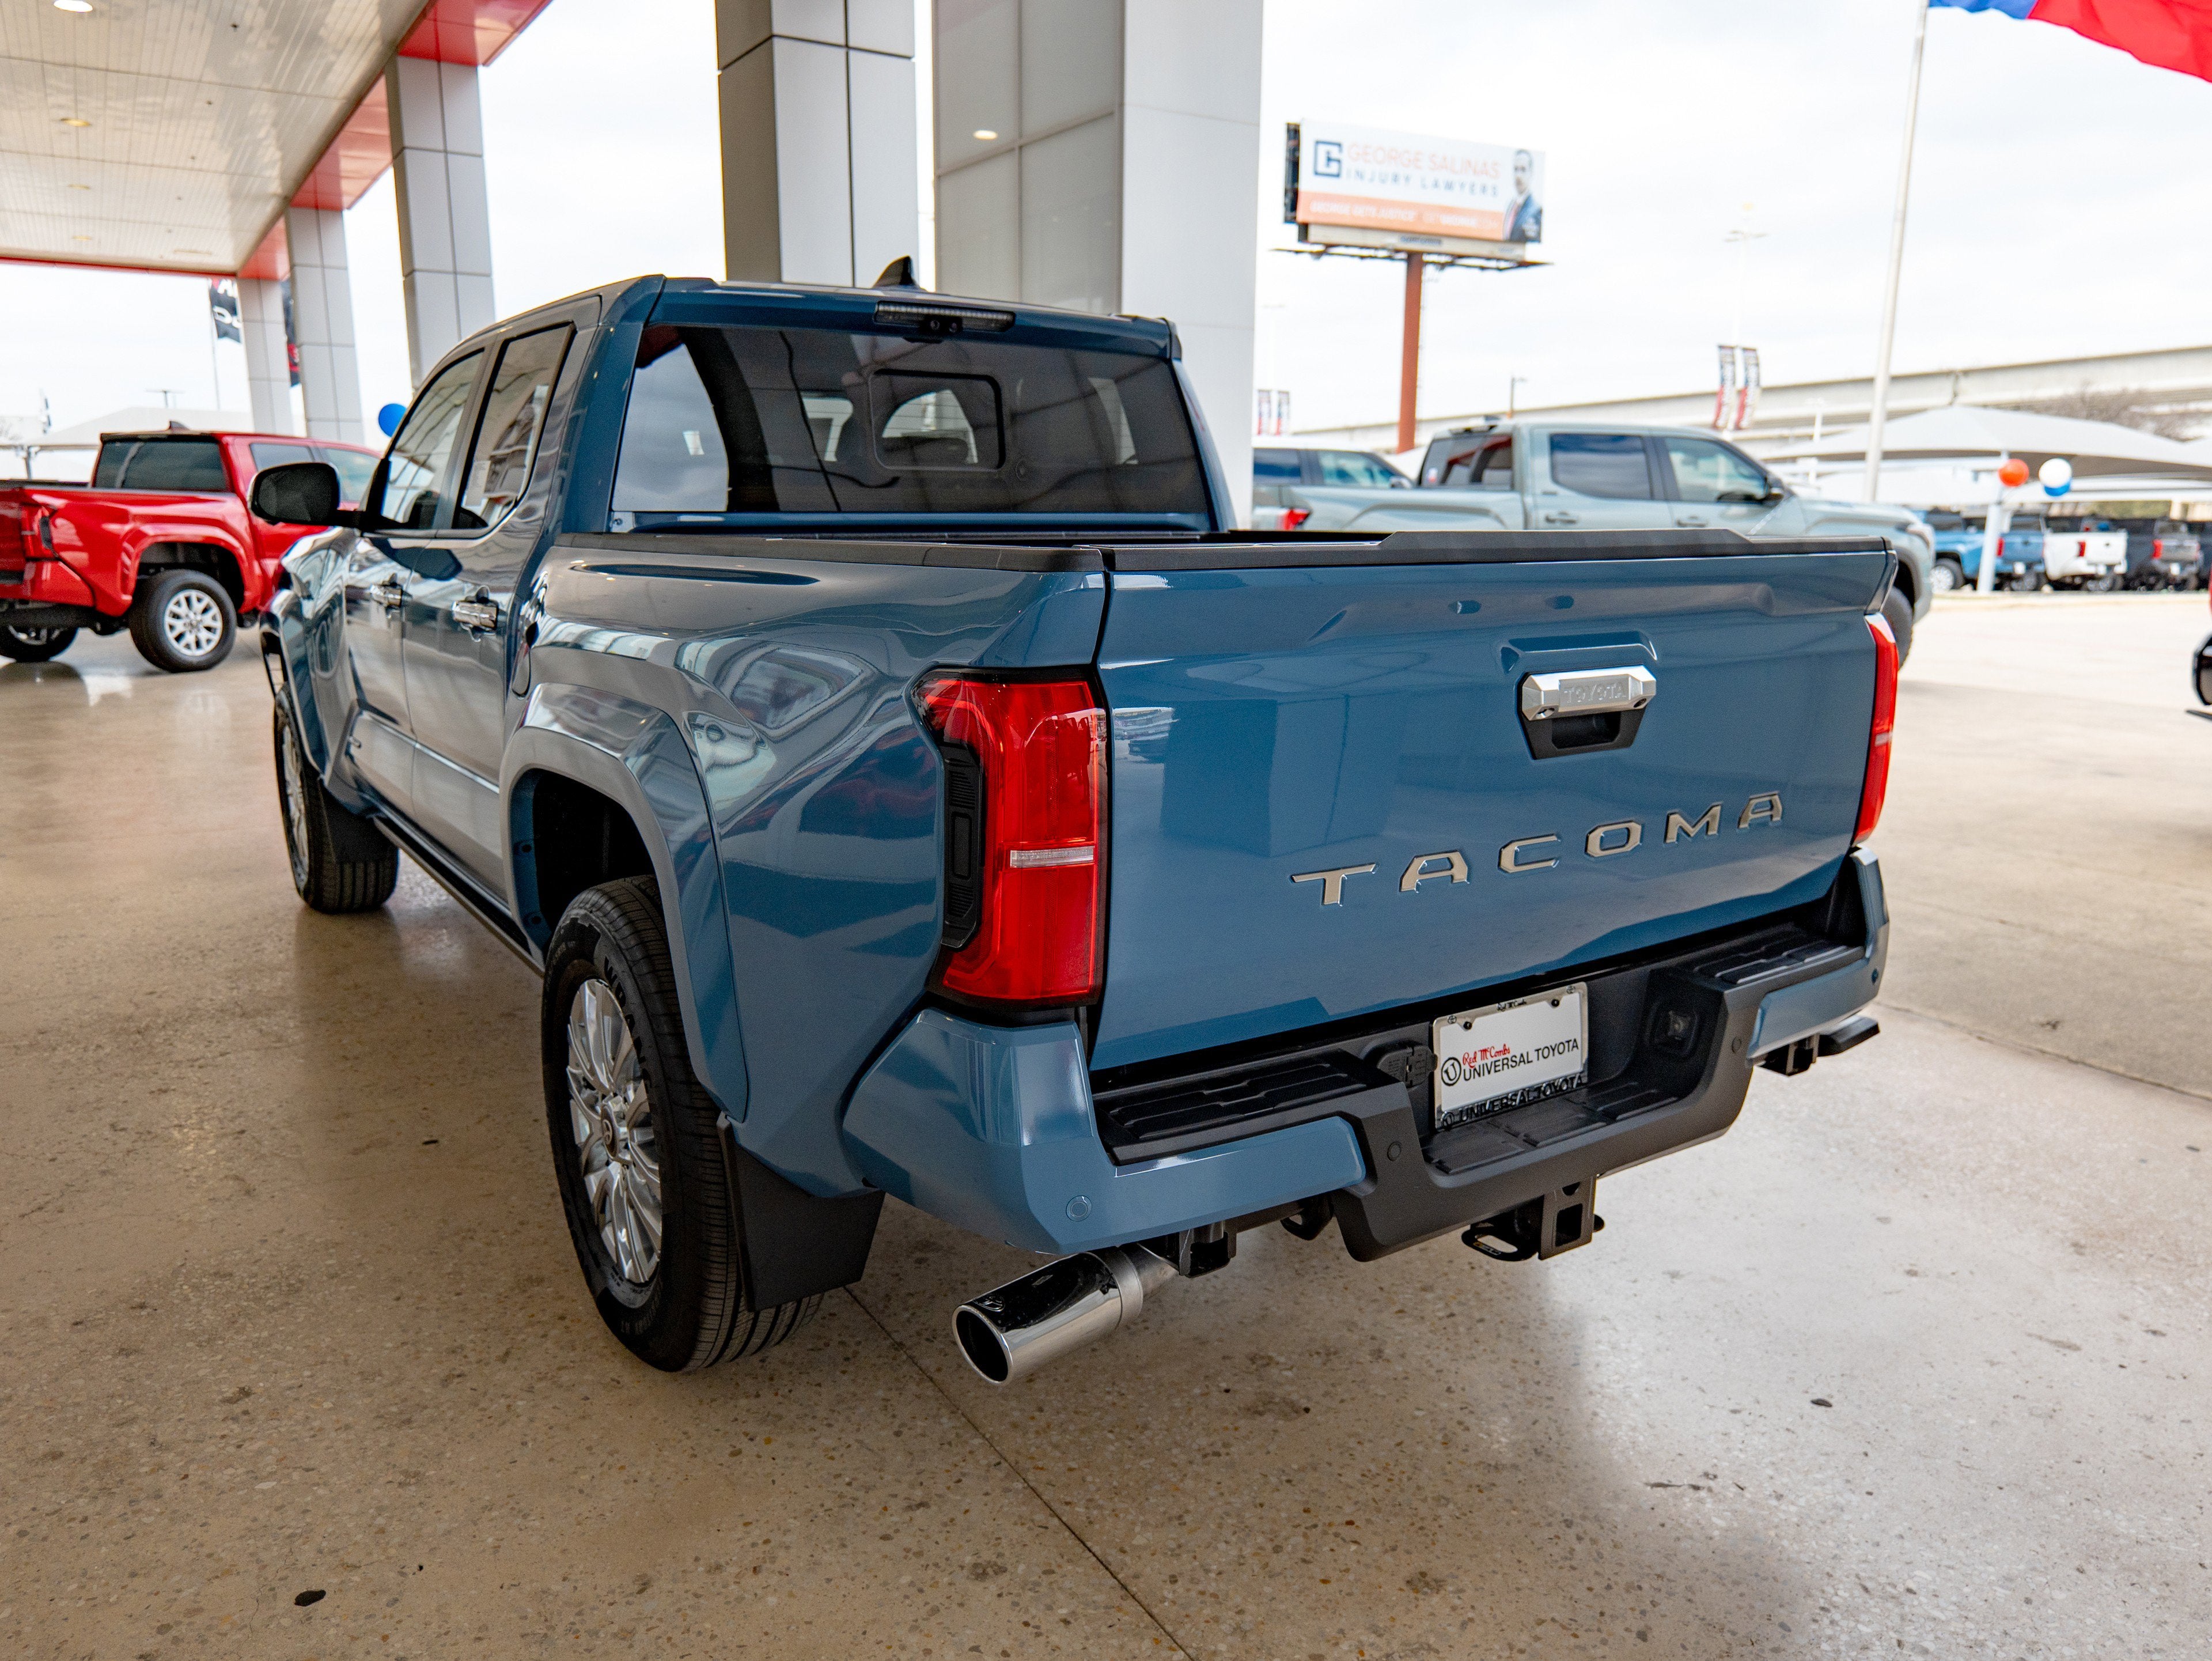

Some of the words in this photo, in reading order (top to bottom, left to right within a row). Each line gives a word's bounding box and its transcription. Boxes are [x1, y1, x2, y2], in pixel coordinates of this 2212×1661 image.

[1347, 142, 1423, 169] GEORGE
[1428, 152, 1502, 179] SALINAS
[1346, 168, 1411, 185] INJURY
[1420, 176, 1499, 198] LAWYERS
[1290, 790, 1783, 907] TACOMA
[1463, 1051, 1477, 1068] Red
[1463, 1053, 1533, 1082] UNIVERSAL
[1535, 1038, 1579, 1061] TOYOTA
[1459, 1087, 1535, 1122] UNIVERSAL
[1535, 1073, 1584, 1100] TOYOTA
